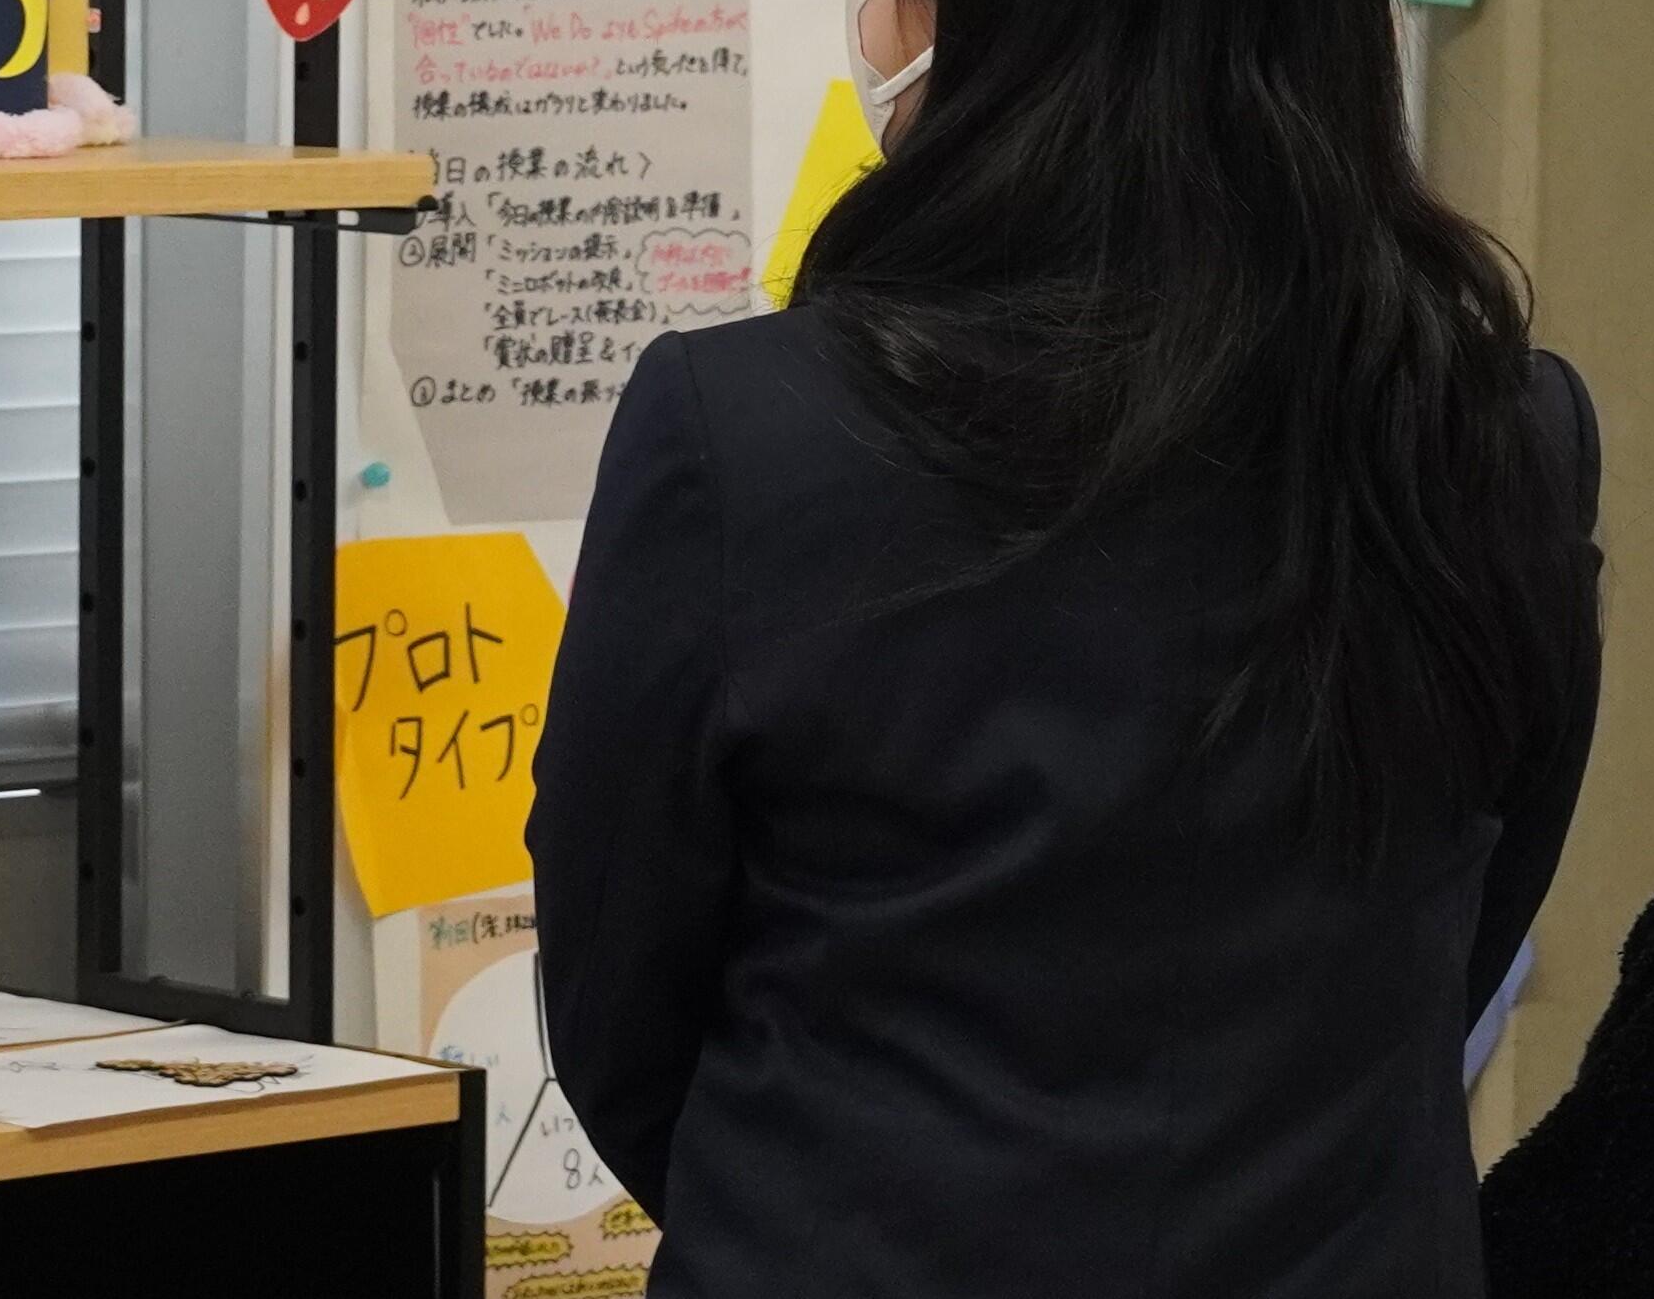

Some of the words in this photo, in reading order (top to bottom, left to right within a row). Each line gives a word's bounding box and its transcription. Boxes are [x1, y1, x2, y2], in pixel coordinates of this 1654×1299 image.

[416, 191, 476, 233] 導入
[333, 602, 504, 712] プロト
[389, 702, 540, 801] タイプ
[562, 1148, 604, 1190] 8人
